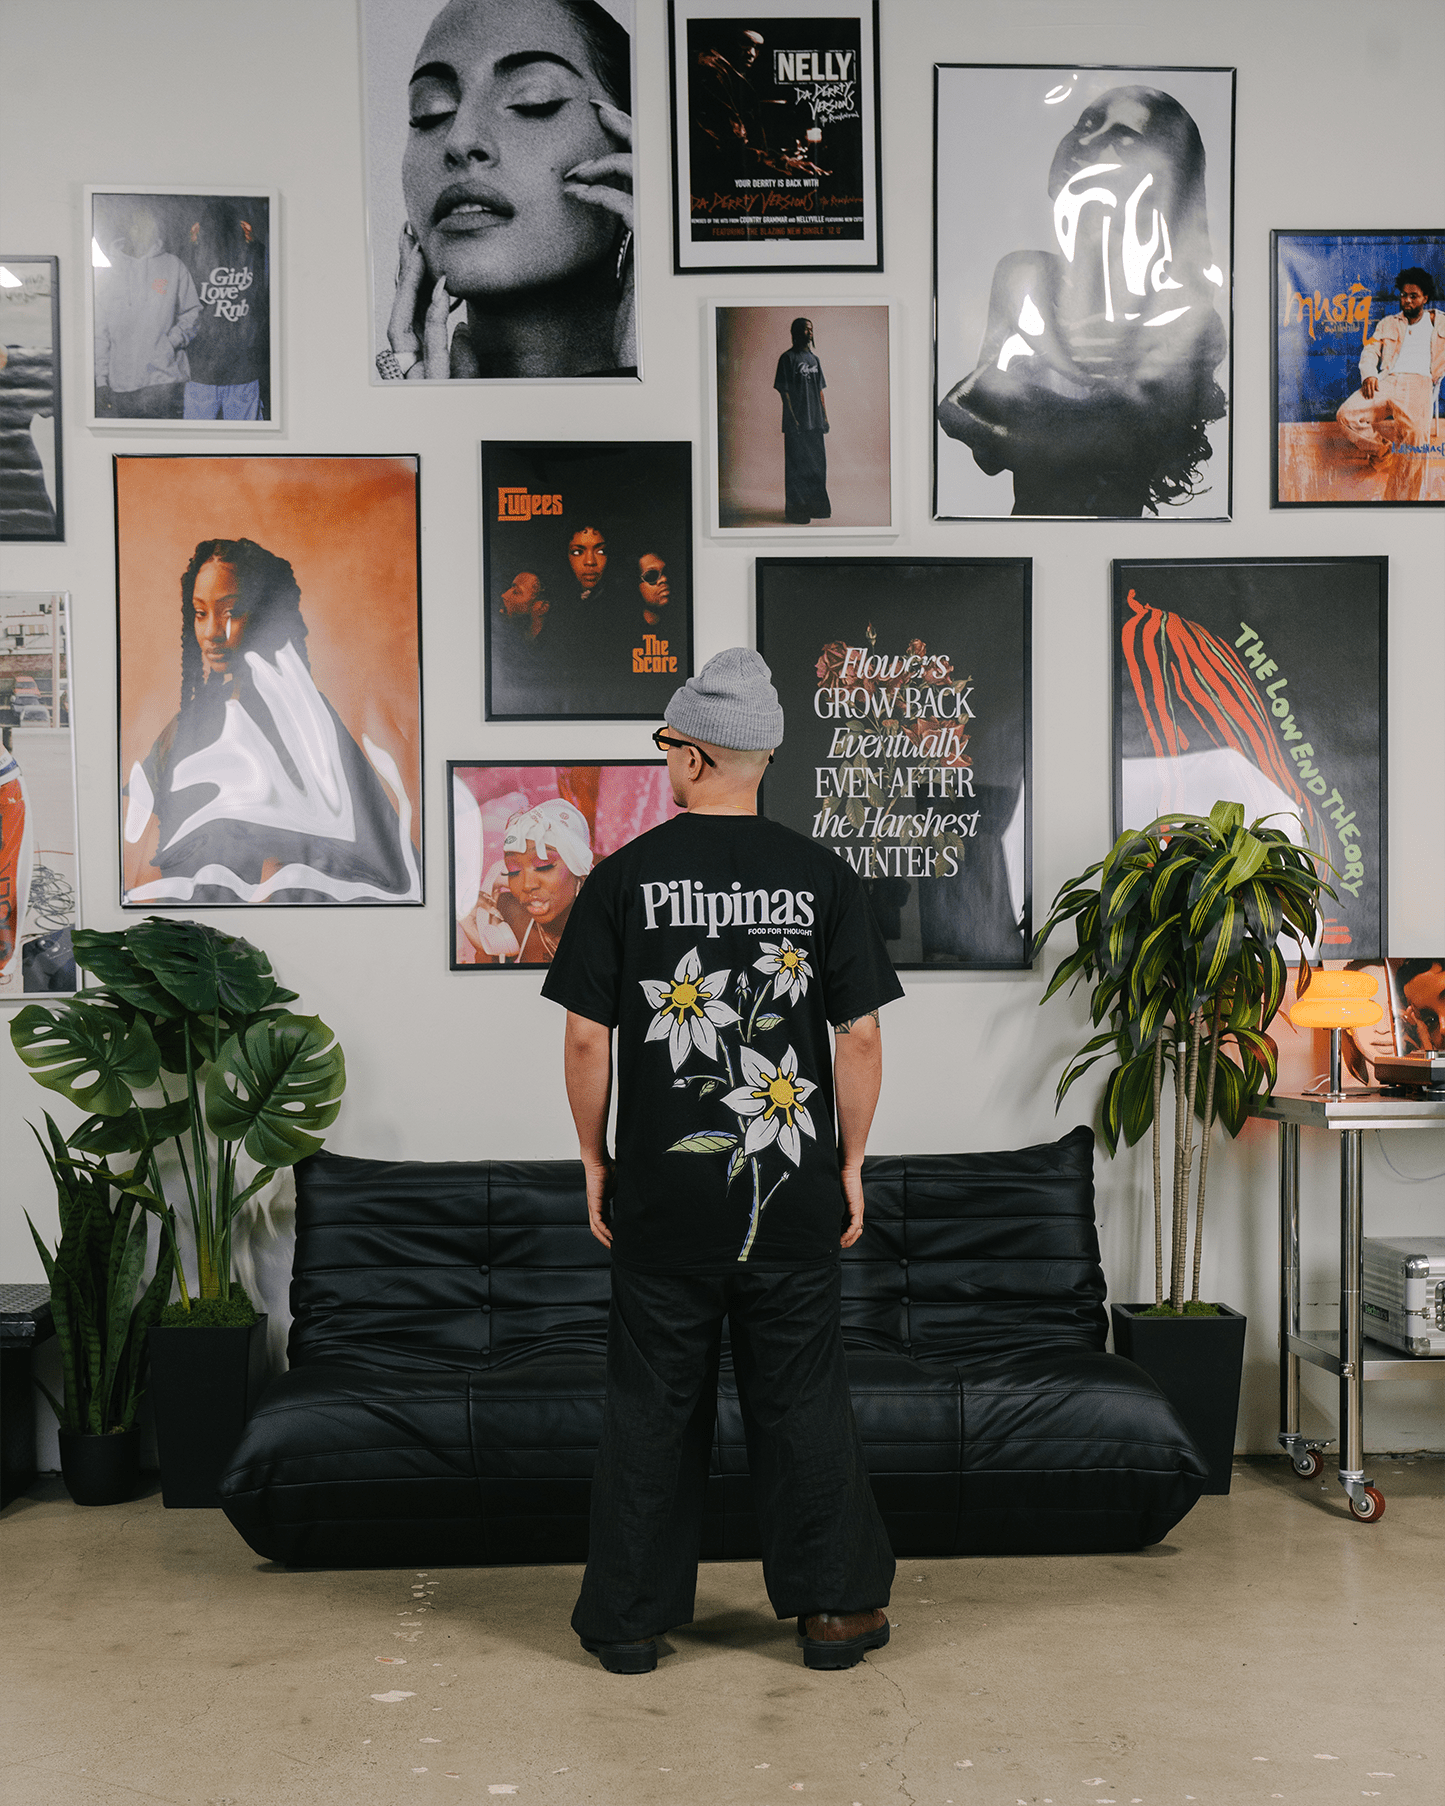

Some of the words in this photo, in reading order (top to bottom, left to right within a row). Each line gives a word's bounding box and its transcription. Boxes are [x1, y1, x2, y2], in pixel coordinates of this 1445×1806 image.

[778, 52, 853, 81] NELLY
[794, 87, 812, 105] DA
[734, 179, 751, 188] YOUR
[752, 179, 776, 188] DERRTY
[777, 179, 784, 188] IS
[786, 179, 802, 188] BACK
[803, 178, 819, 188] WITH
[796, 215, 824, 223] NELLYVILLE
[210, 267, 253, 291] Girls
[200, 282, 239, 304] Love
[213, 299, 250, 321] Rnb
[498, 487, 563, 521] Fugees
[642, 634, 669, 655] The
[632, 648, 678, 673] Score
[838, 647, 950, 680] Flowers
[814, 687, 899, 719] GROW
[904, 687, 976, 719] BACK
[827, 727, 969, 765] Eventually
[1235, 622, 1278, 680] THE
[1266, 678, 1303, 741] LOW
[1290, 743, 1327, 795] END
[1322, 788, 1364, 898] THEORY
[815, 767, 884, 798] EVEN
[888, 767, 976, 798] AFTER
[812, 807, 854, 838] the
[856, 806, 981, 838] Harshest
[640, 880, 815, 939] Pilipinas
[782, 928, 813, 936] THOUGHT
